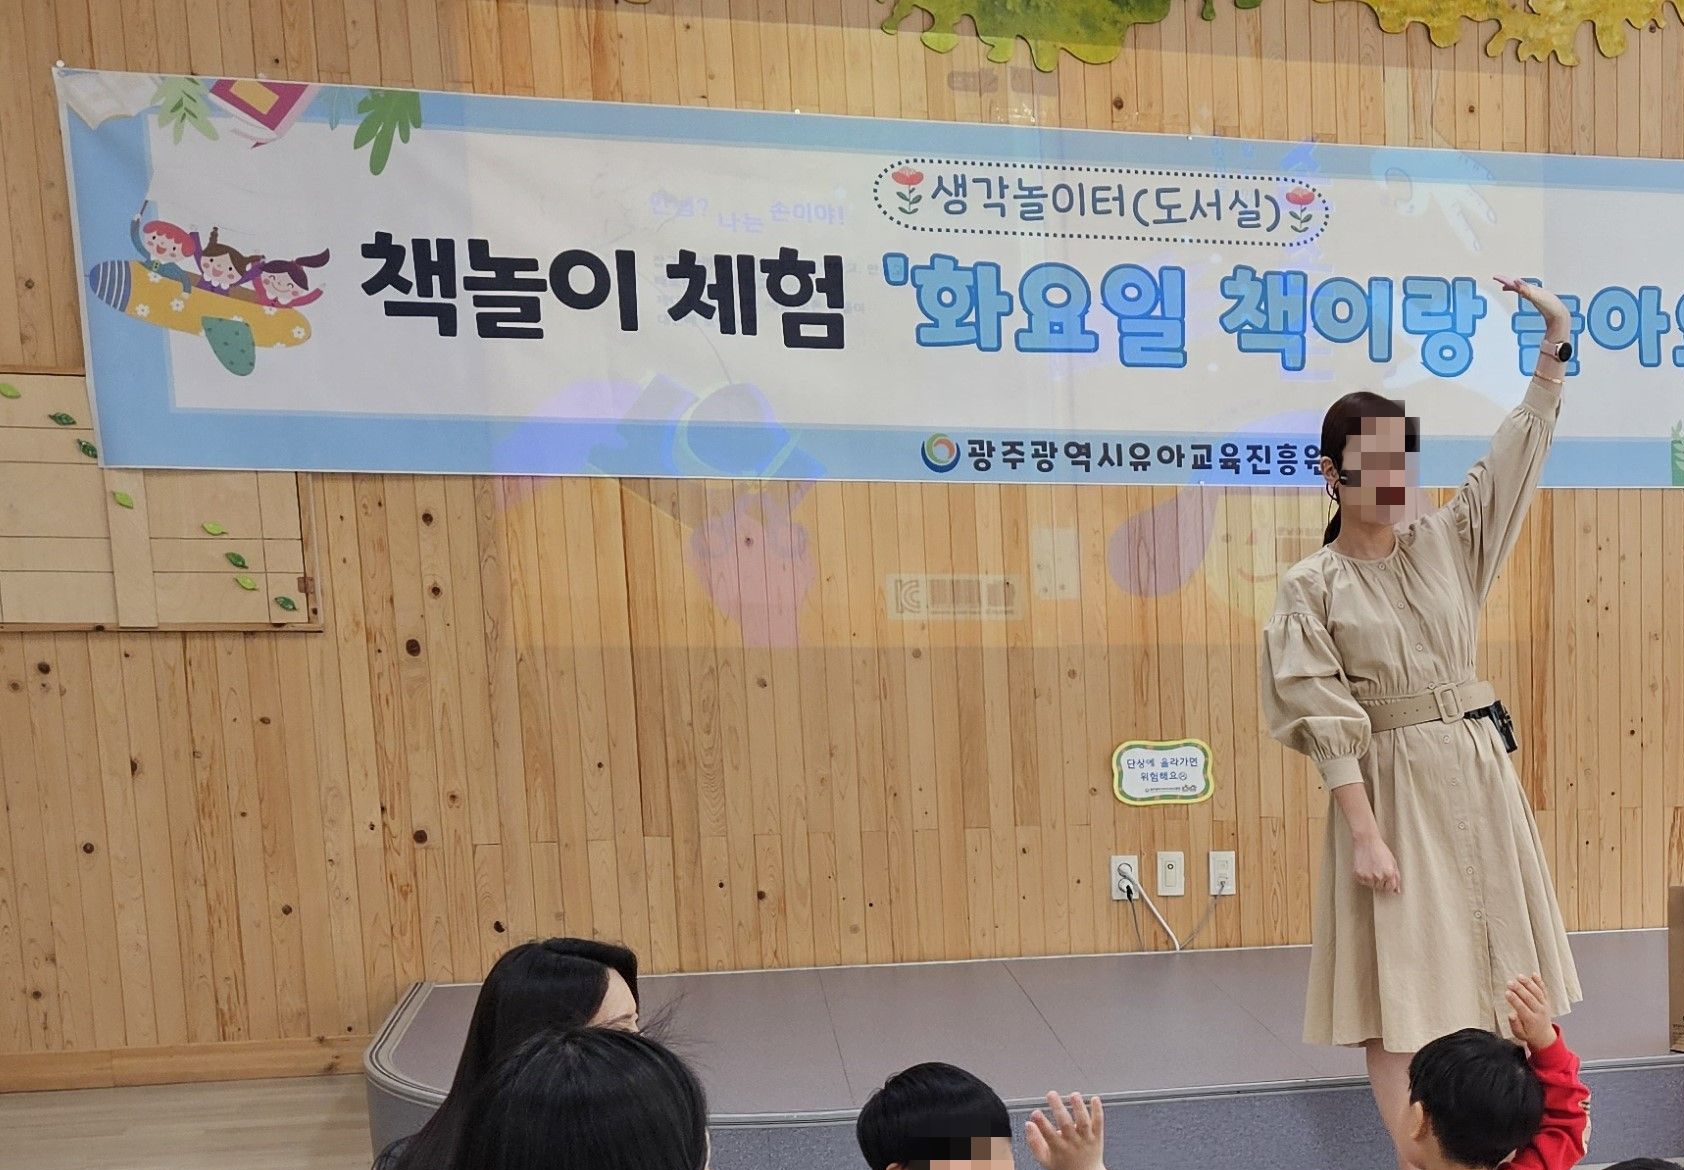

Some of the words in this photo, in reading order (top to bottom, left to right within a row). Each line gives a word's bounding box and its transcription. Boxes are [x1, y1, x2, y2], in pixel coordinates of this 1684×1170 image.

[931, 173, 1282, 232] 생각놀이터(도서실)
[361, 231, 639, 339] 책놀이
[666, 246, 845, 349] 체험
[883, 252, 1188, 369] '화요일
[1219, 264, 1487, 378] 책이랑
